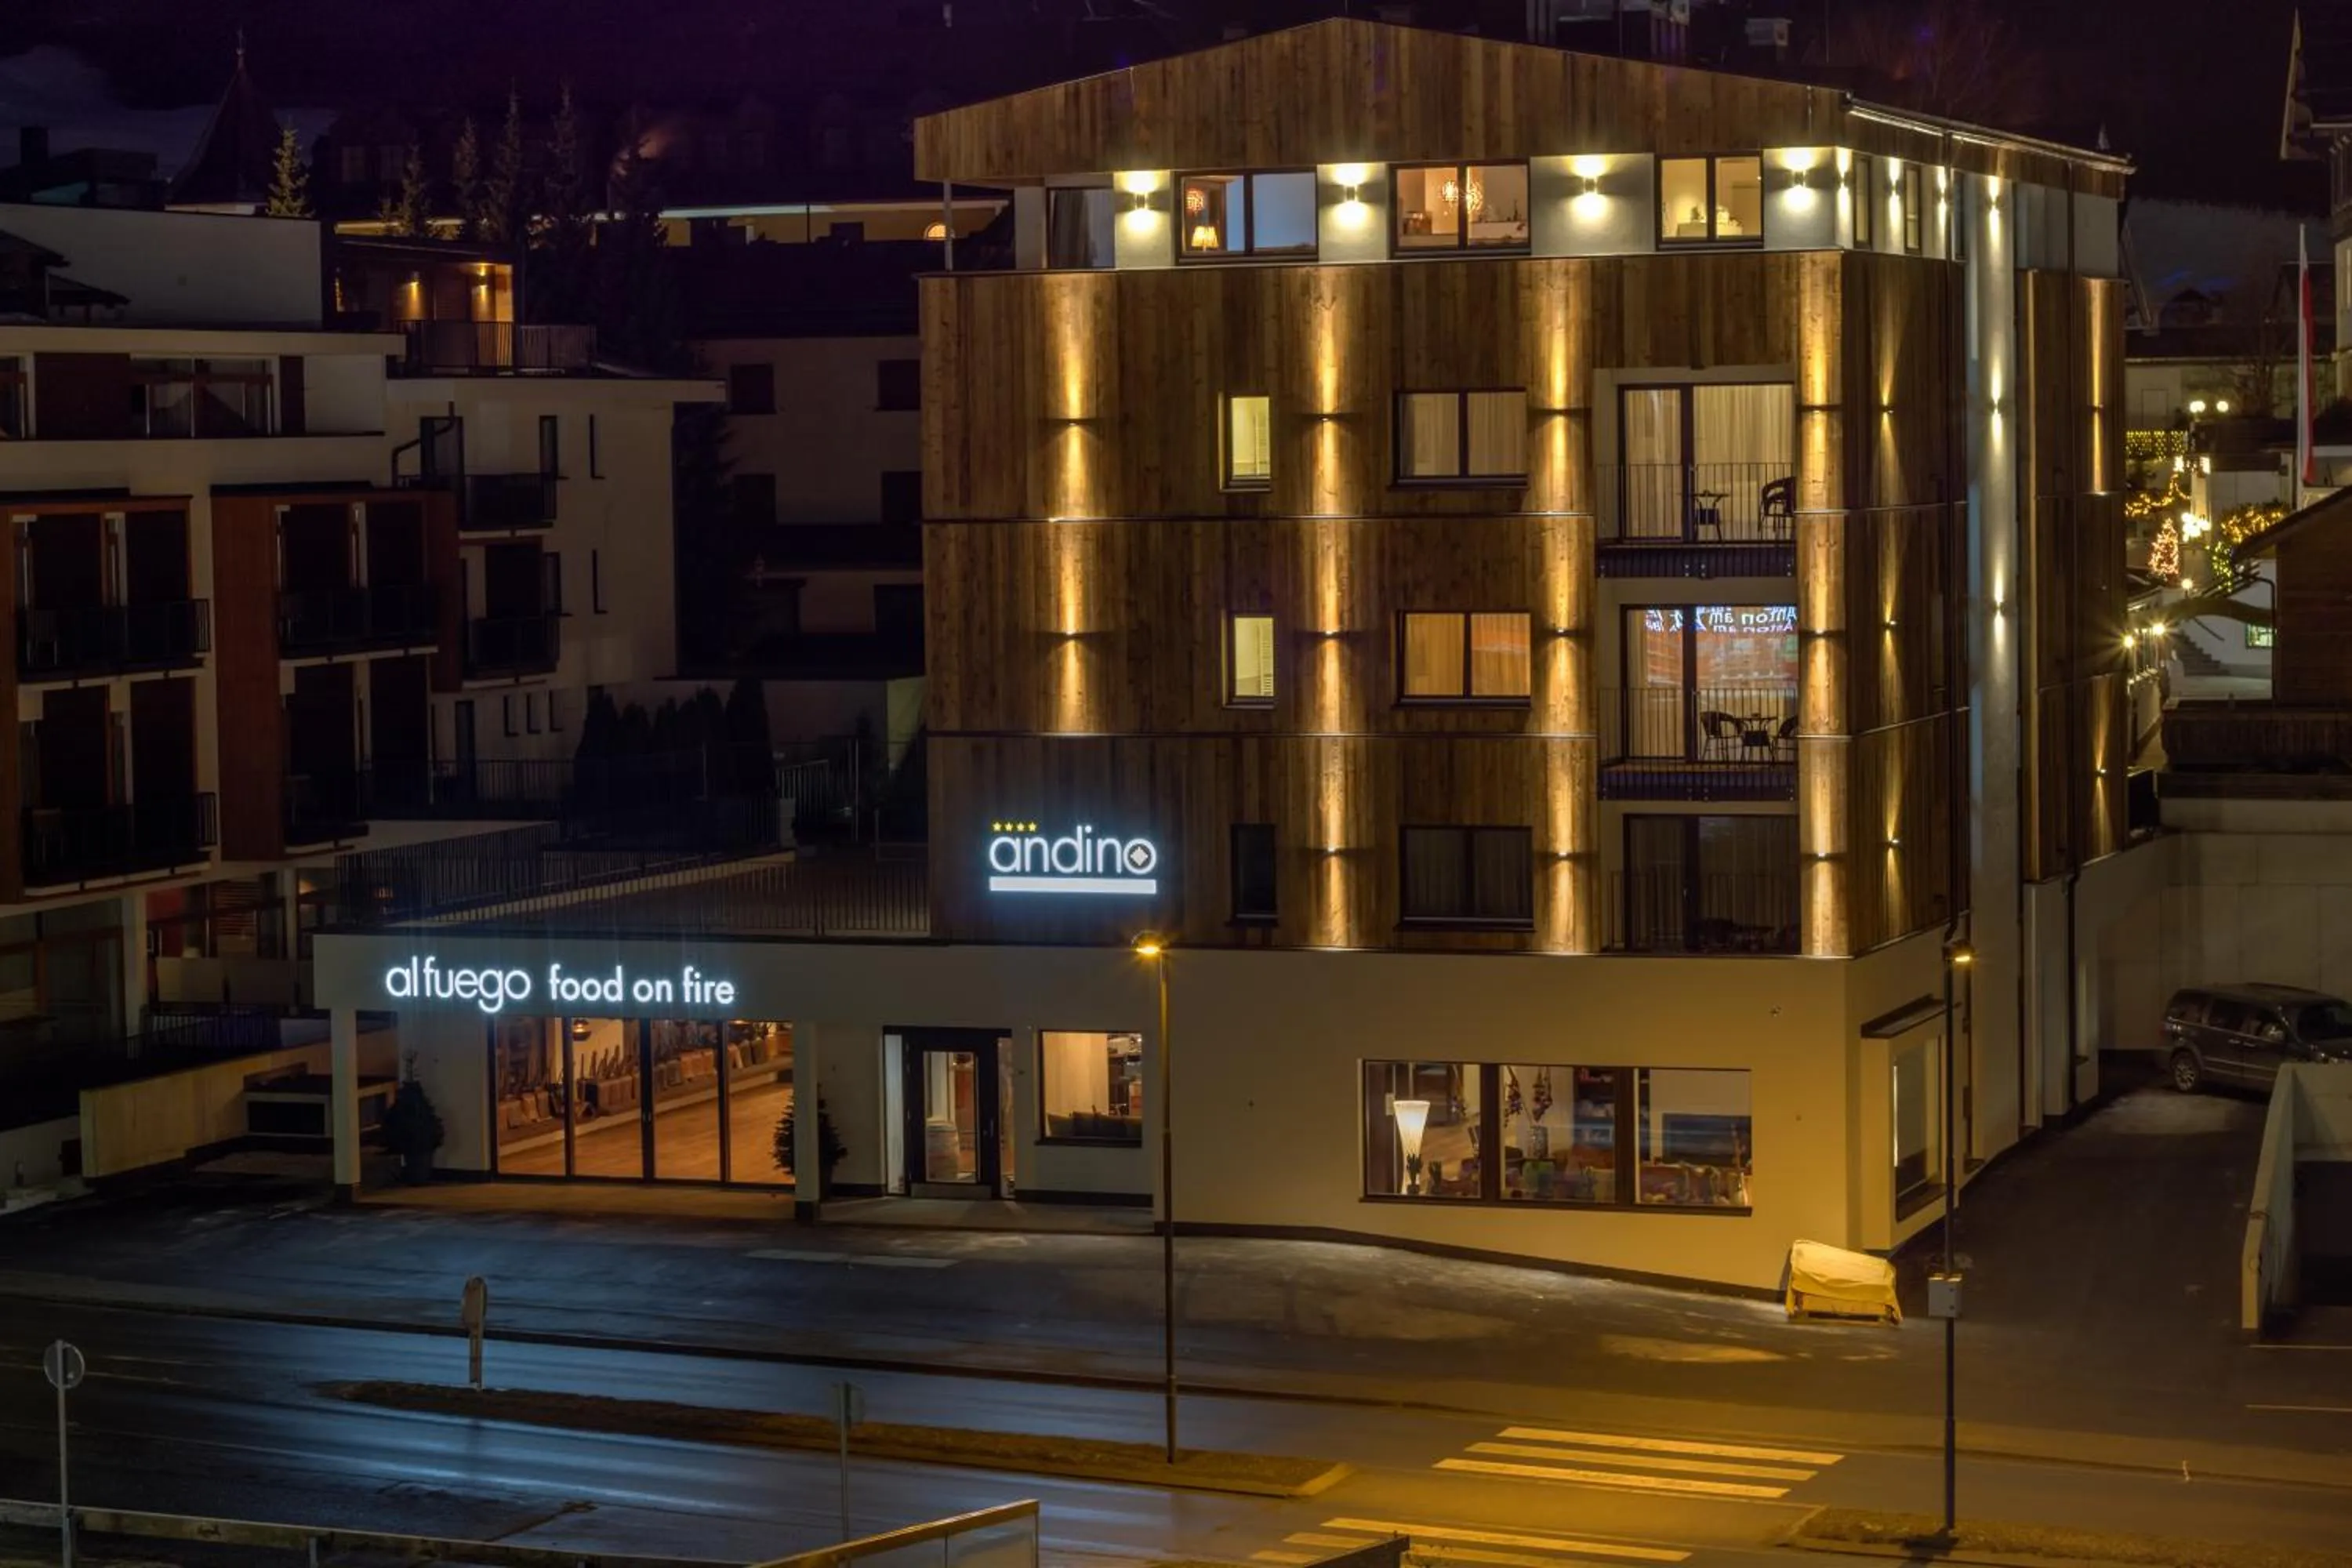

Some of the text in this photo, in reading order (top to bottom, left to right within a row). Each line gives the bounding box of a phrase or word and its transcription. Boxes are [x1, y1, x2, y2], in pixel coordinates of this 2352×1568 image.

[989, 826, 1156, 874] andino
[548, 964, 623, 1001] food
[633, 978, 673, 1003] on
[682, 967, 735, 1004] fire
